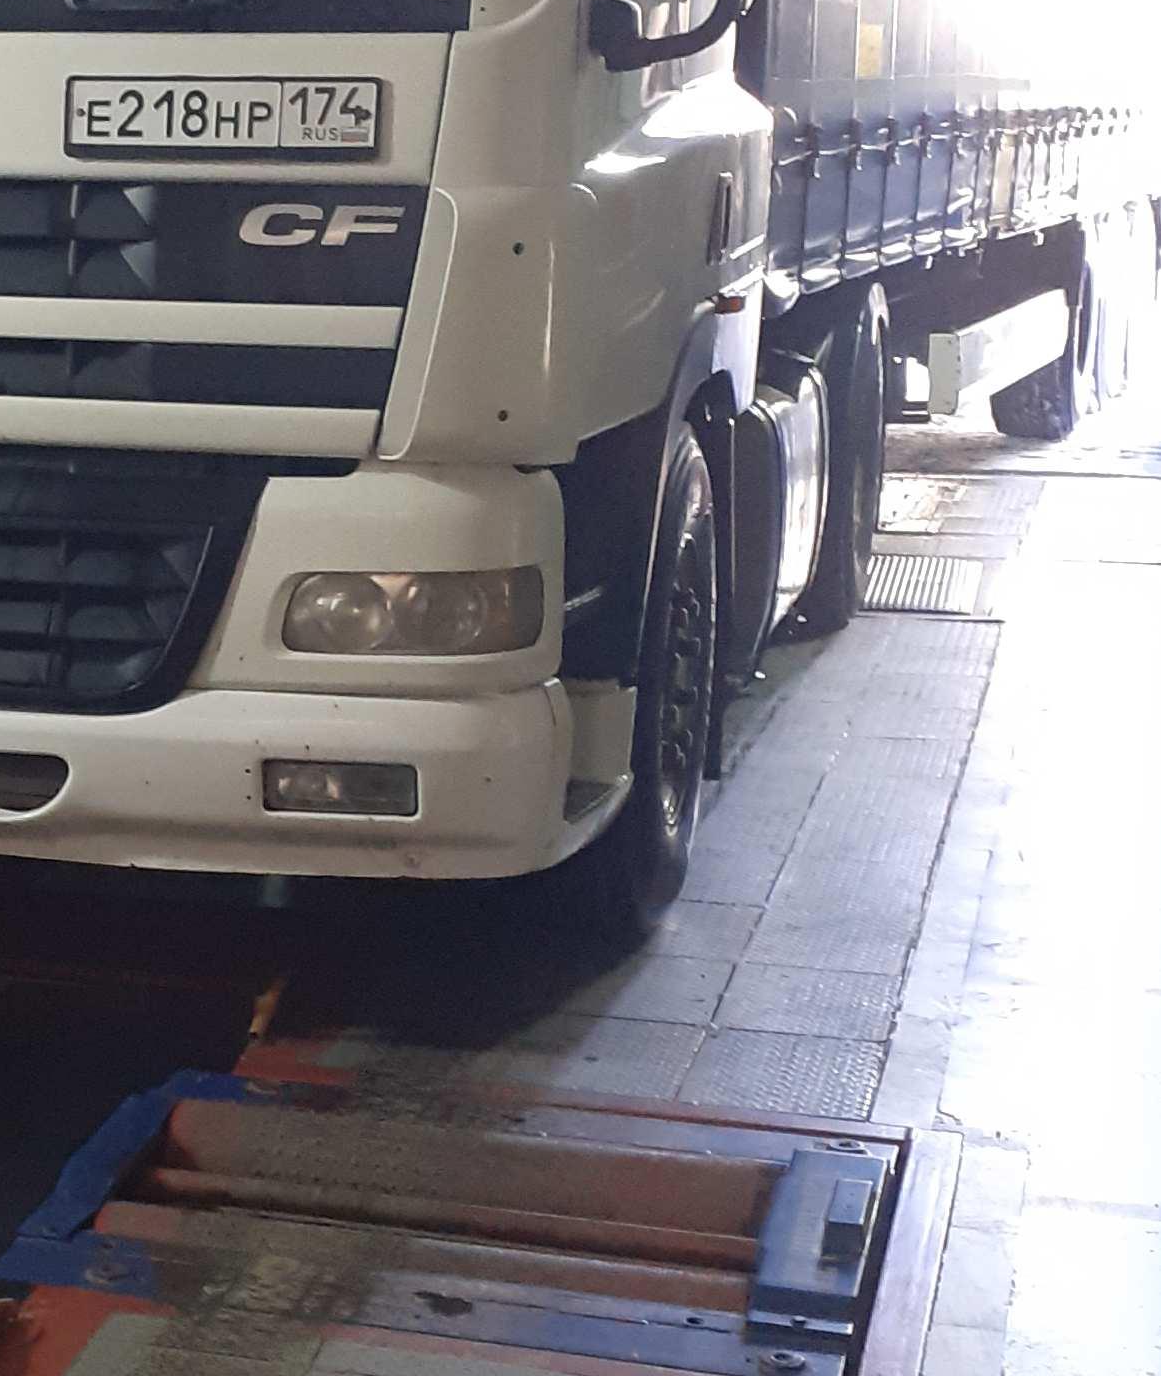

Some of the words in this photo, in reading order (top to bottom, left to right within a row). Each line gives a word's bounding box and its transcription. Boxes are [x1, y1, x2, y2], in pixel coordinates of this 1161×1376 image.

[288, 86, 366, 127] 174
[301, 126, 339, 141] RUS
[239, 203, 406, 247] CF
